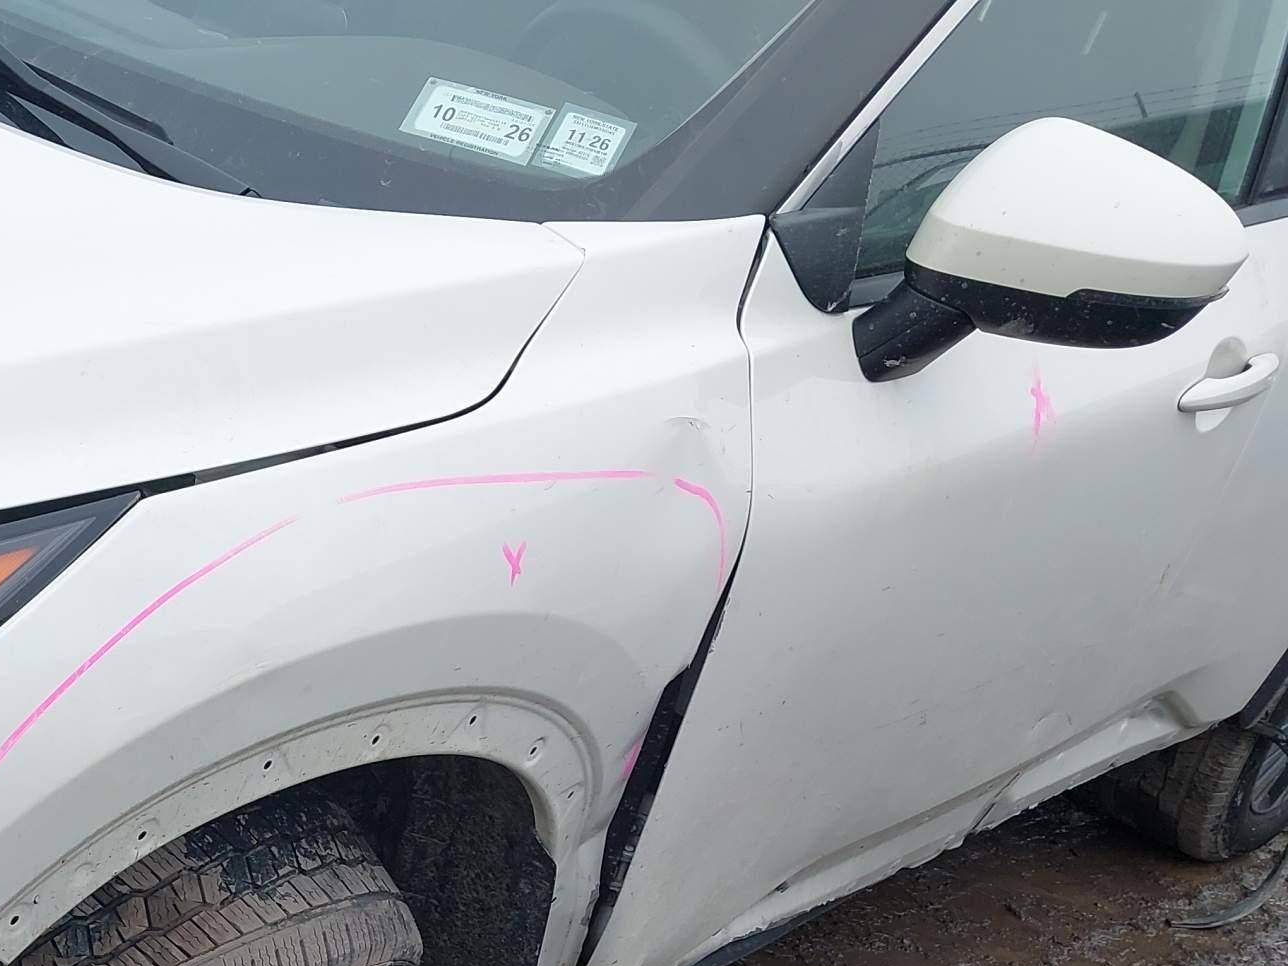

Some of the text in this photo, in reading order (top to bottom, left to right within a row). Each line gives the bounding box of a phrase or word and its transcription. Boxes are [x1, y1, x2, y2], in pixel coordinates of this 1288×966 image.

[432, 104, 456, 122] 10
[504, 124, 533, 142] 26
[568, 129, 587, 143] 11
[589, 135, 612, 151] 26
